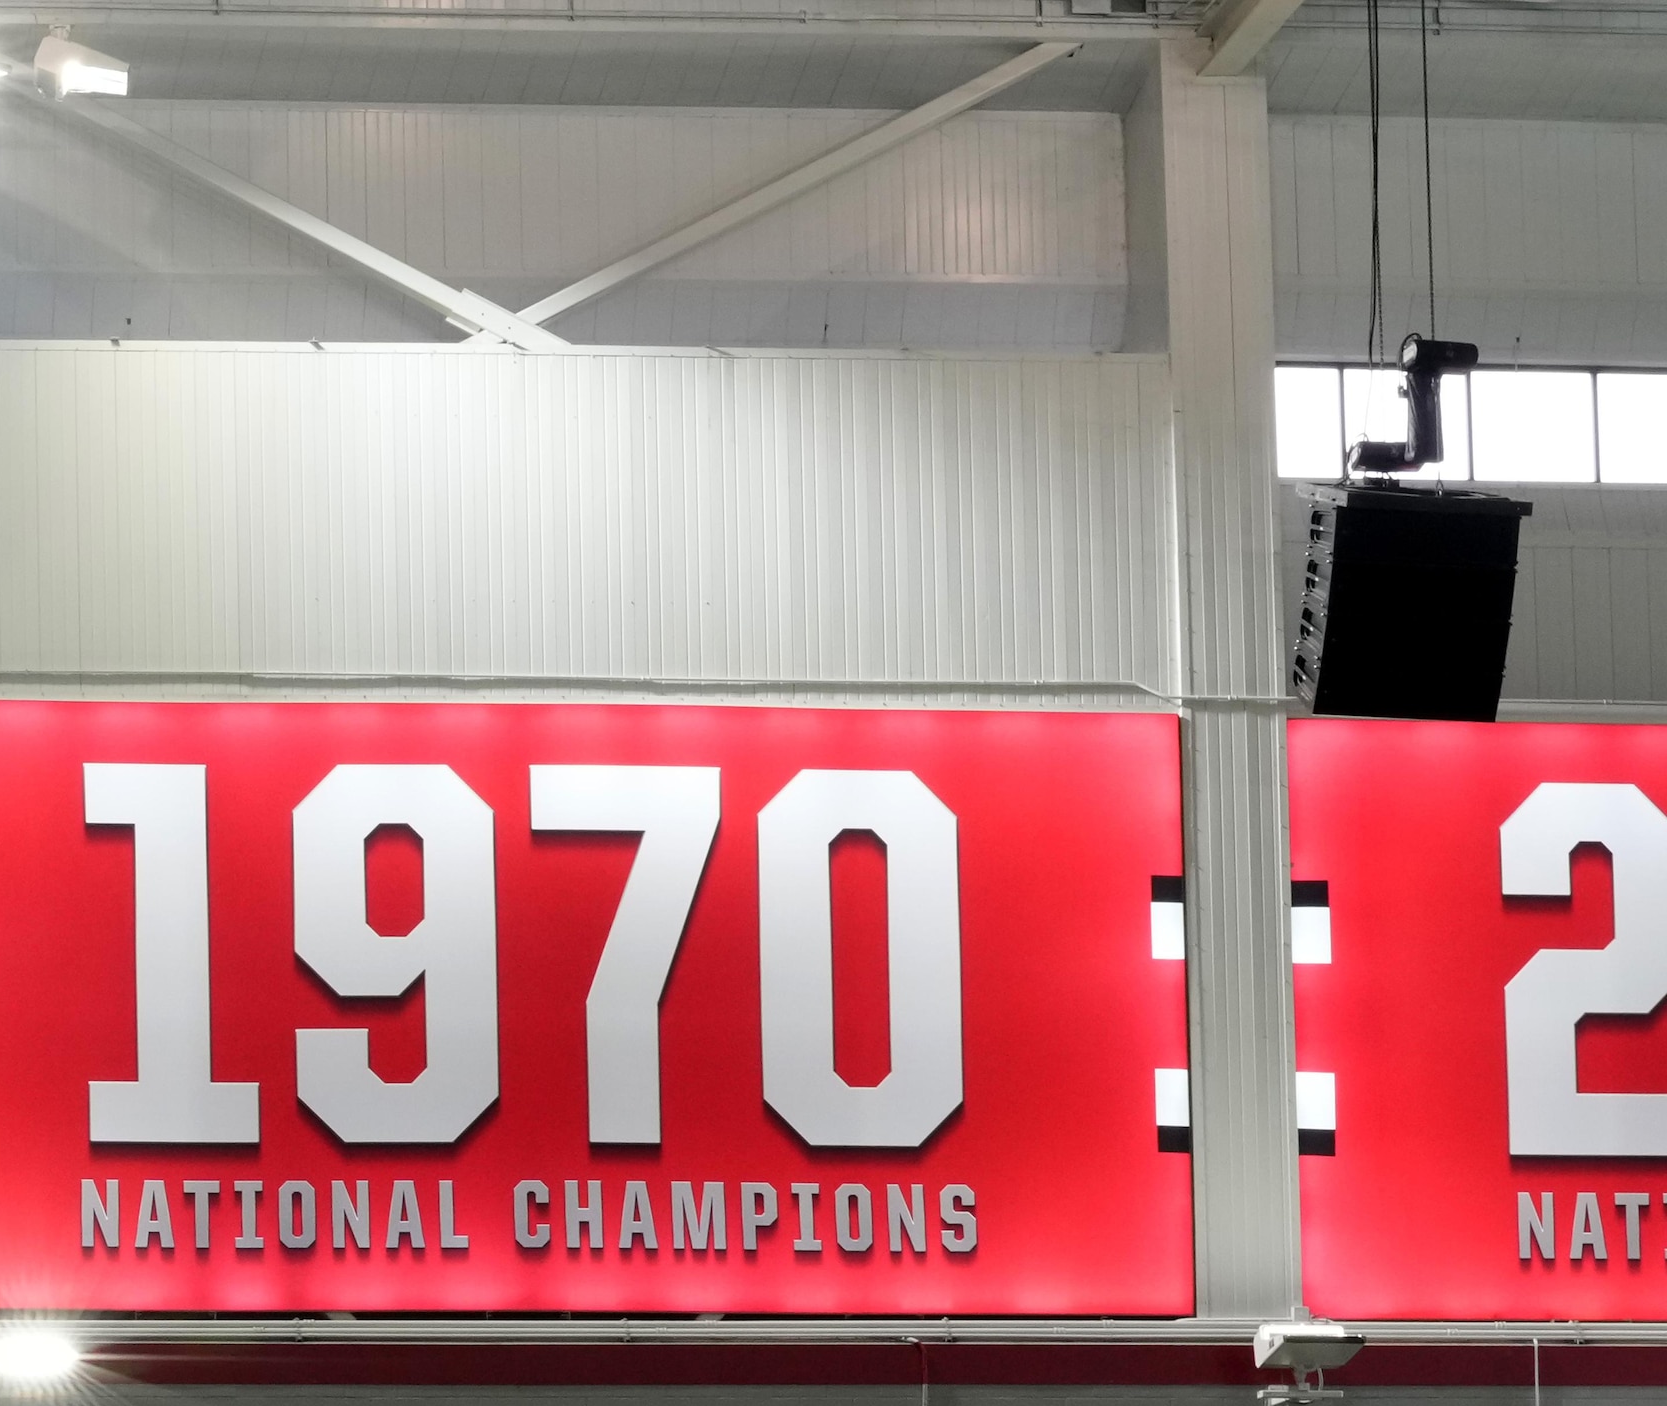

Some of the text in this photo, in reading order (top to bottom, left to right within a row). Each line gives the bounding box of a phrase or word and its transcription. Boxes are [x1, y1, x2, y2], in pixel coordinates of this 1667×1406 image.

[82, 762, 964, 1148] 1970
[81, 1179, 978, 1252] NATIONAL CHAMPIONS
[1518, 1192, 1667, 1260] NAT
